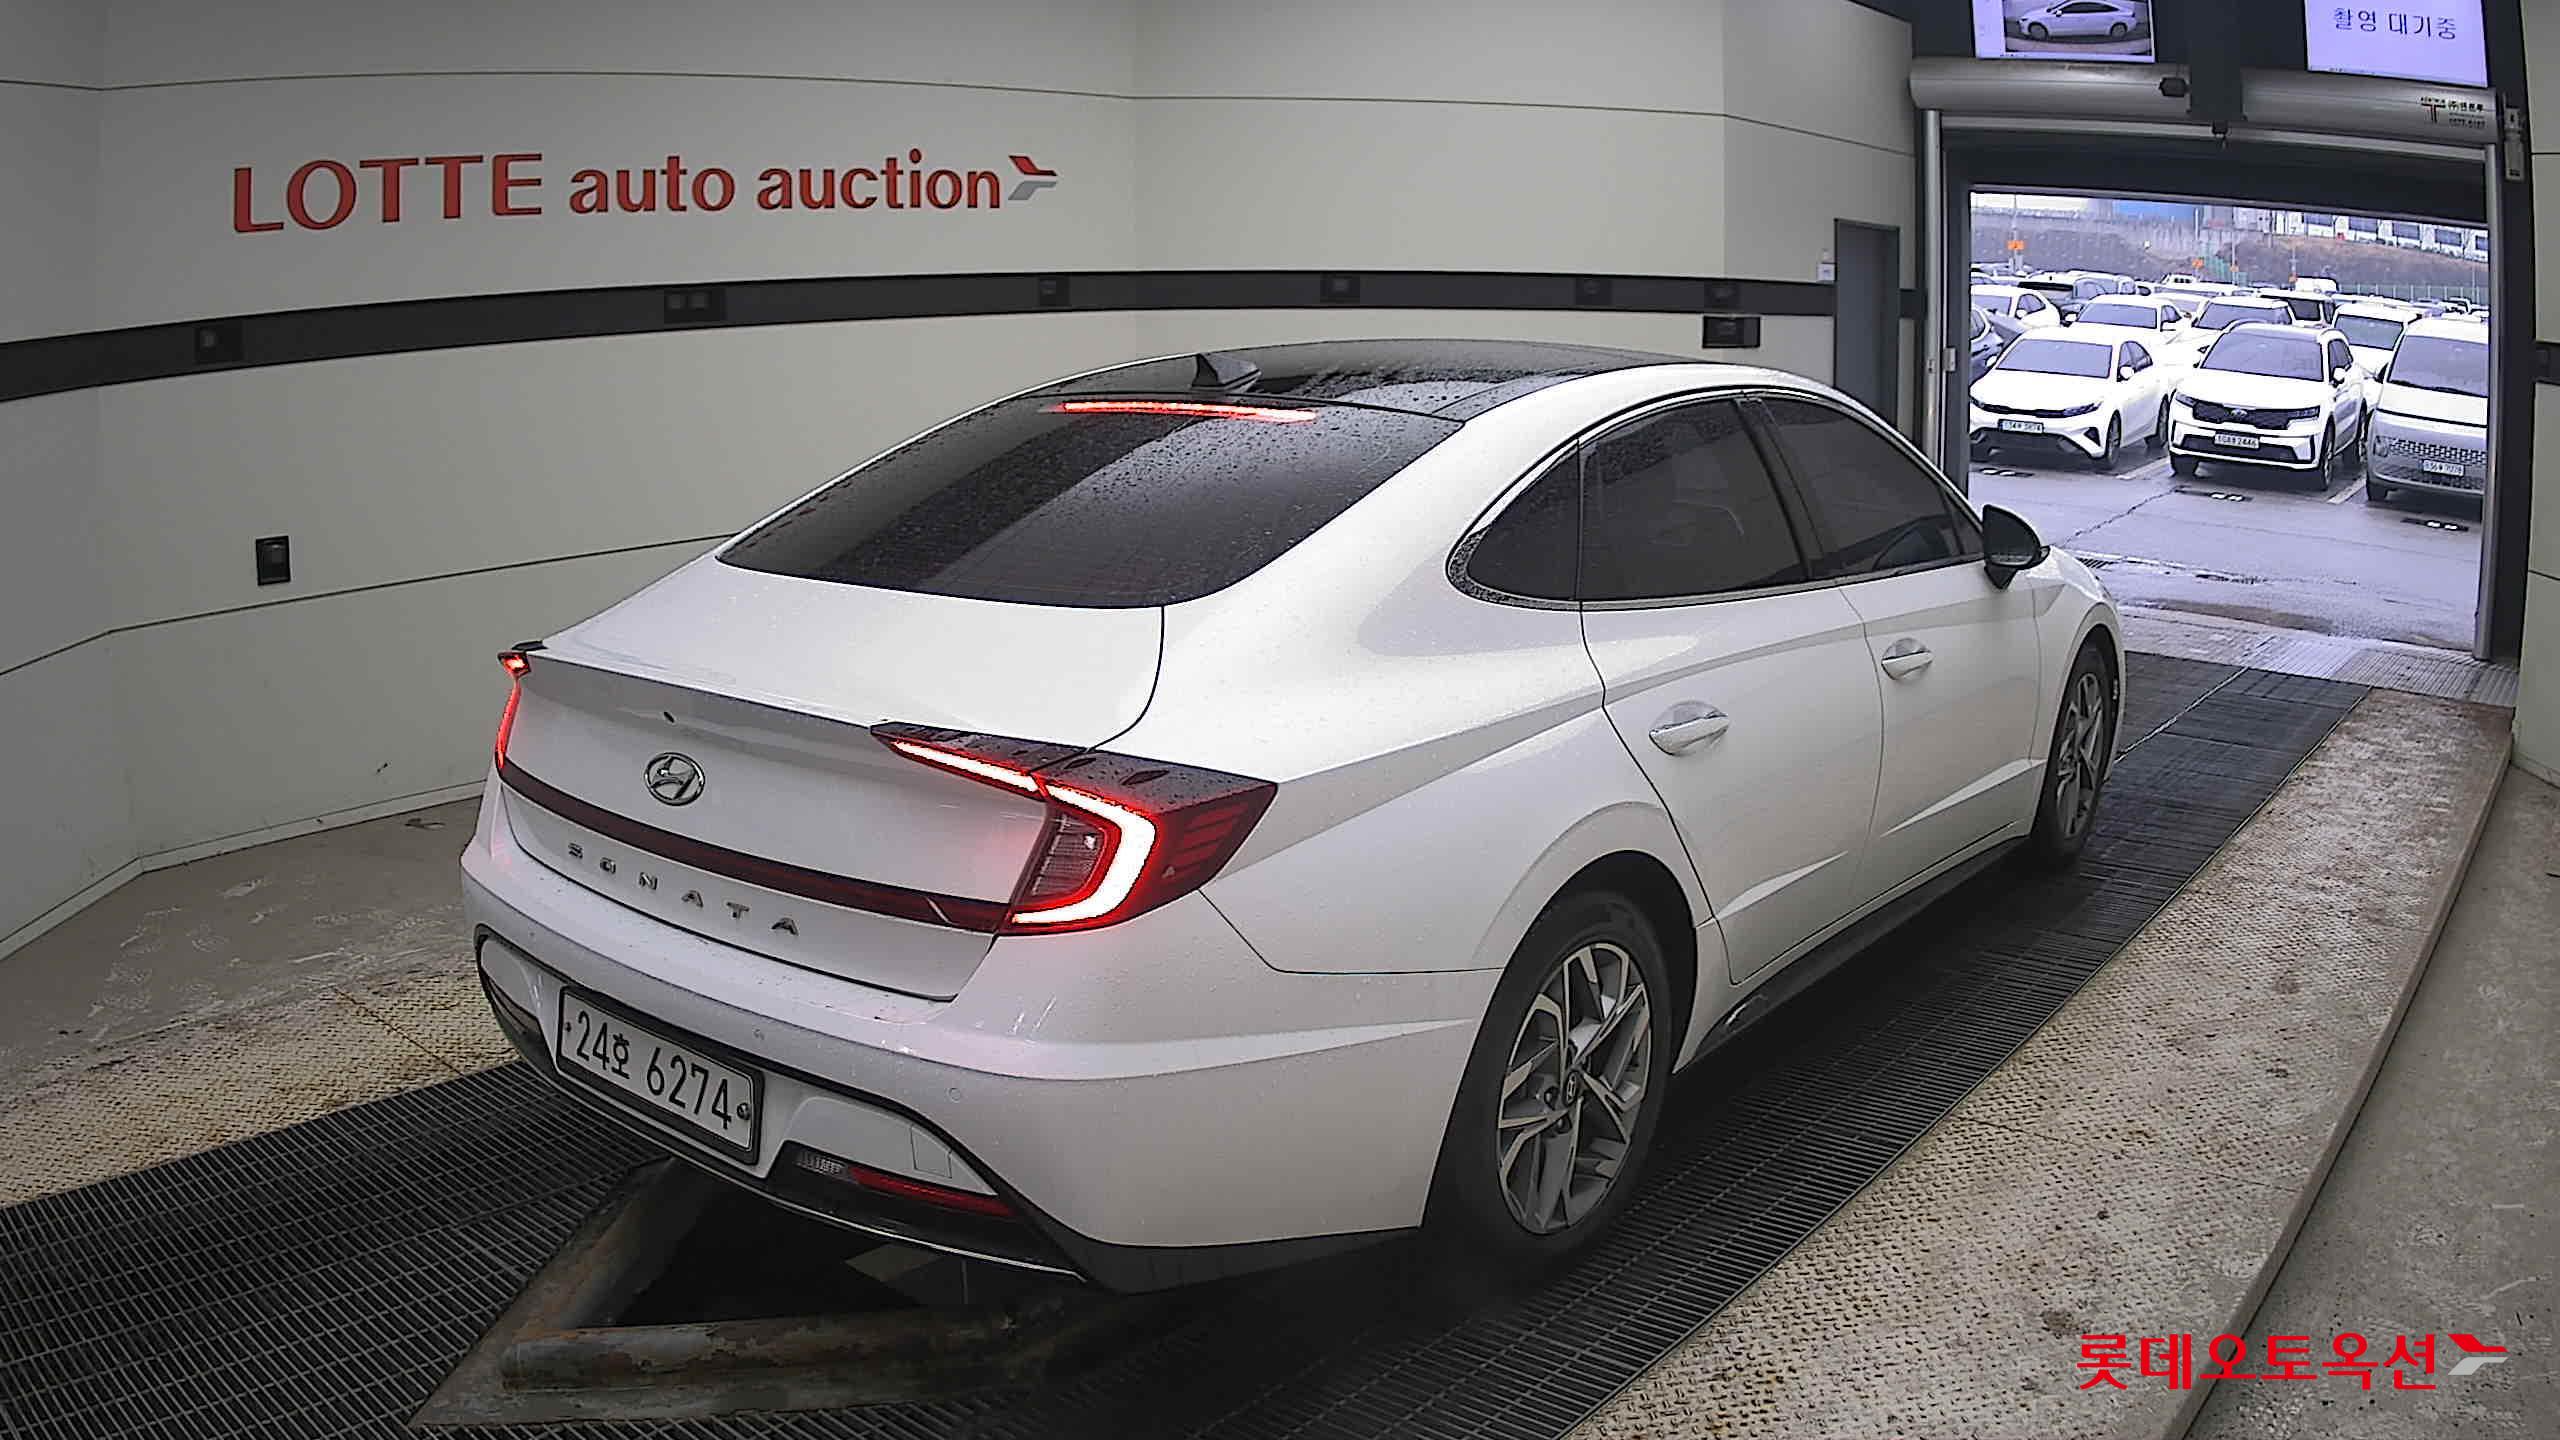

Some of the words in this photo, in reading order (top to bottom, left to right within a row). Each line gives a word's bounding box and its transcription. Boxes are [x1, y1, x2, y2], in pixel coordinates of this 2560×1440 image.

[2334, 7, 2377, 32] 촬영
[2388, 13, 2457, 40] 대기중
[233, 152, 543, 233] LOTTE
[568, 155, 736, 213] auto
[756, 147, 1002, 210] auction
[567, 842, 800, 937] SONATA
[575, 1009, 631, 1080] 24호
[645, 1046, 733, 1131] 6274
